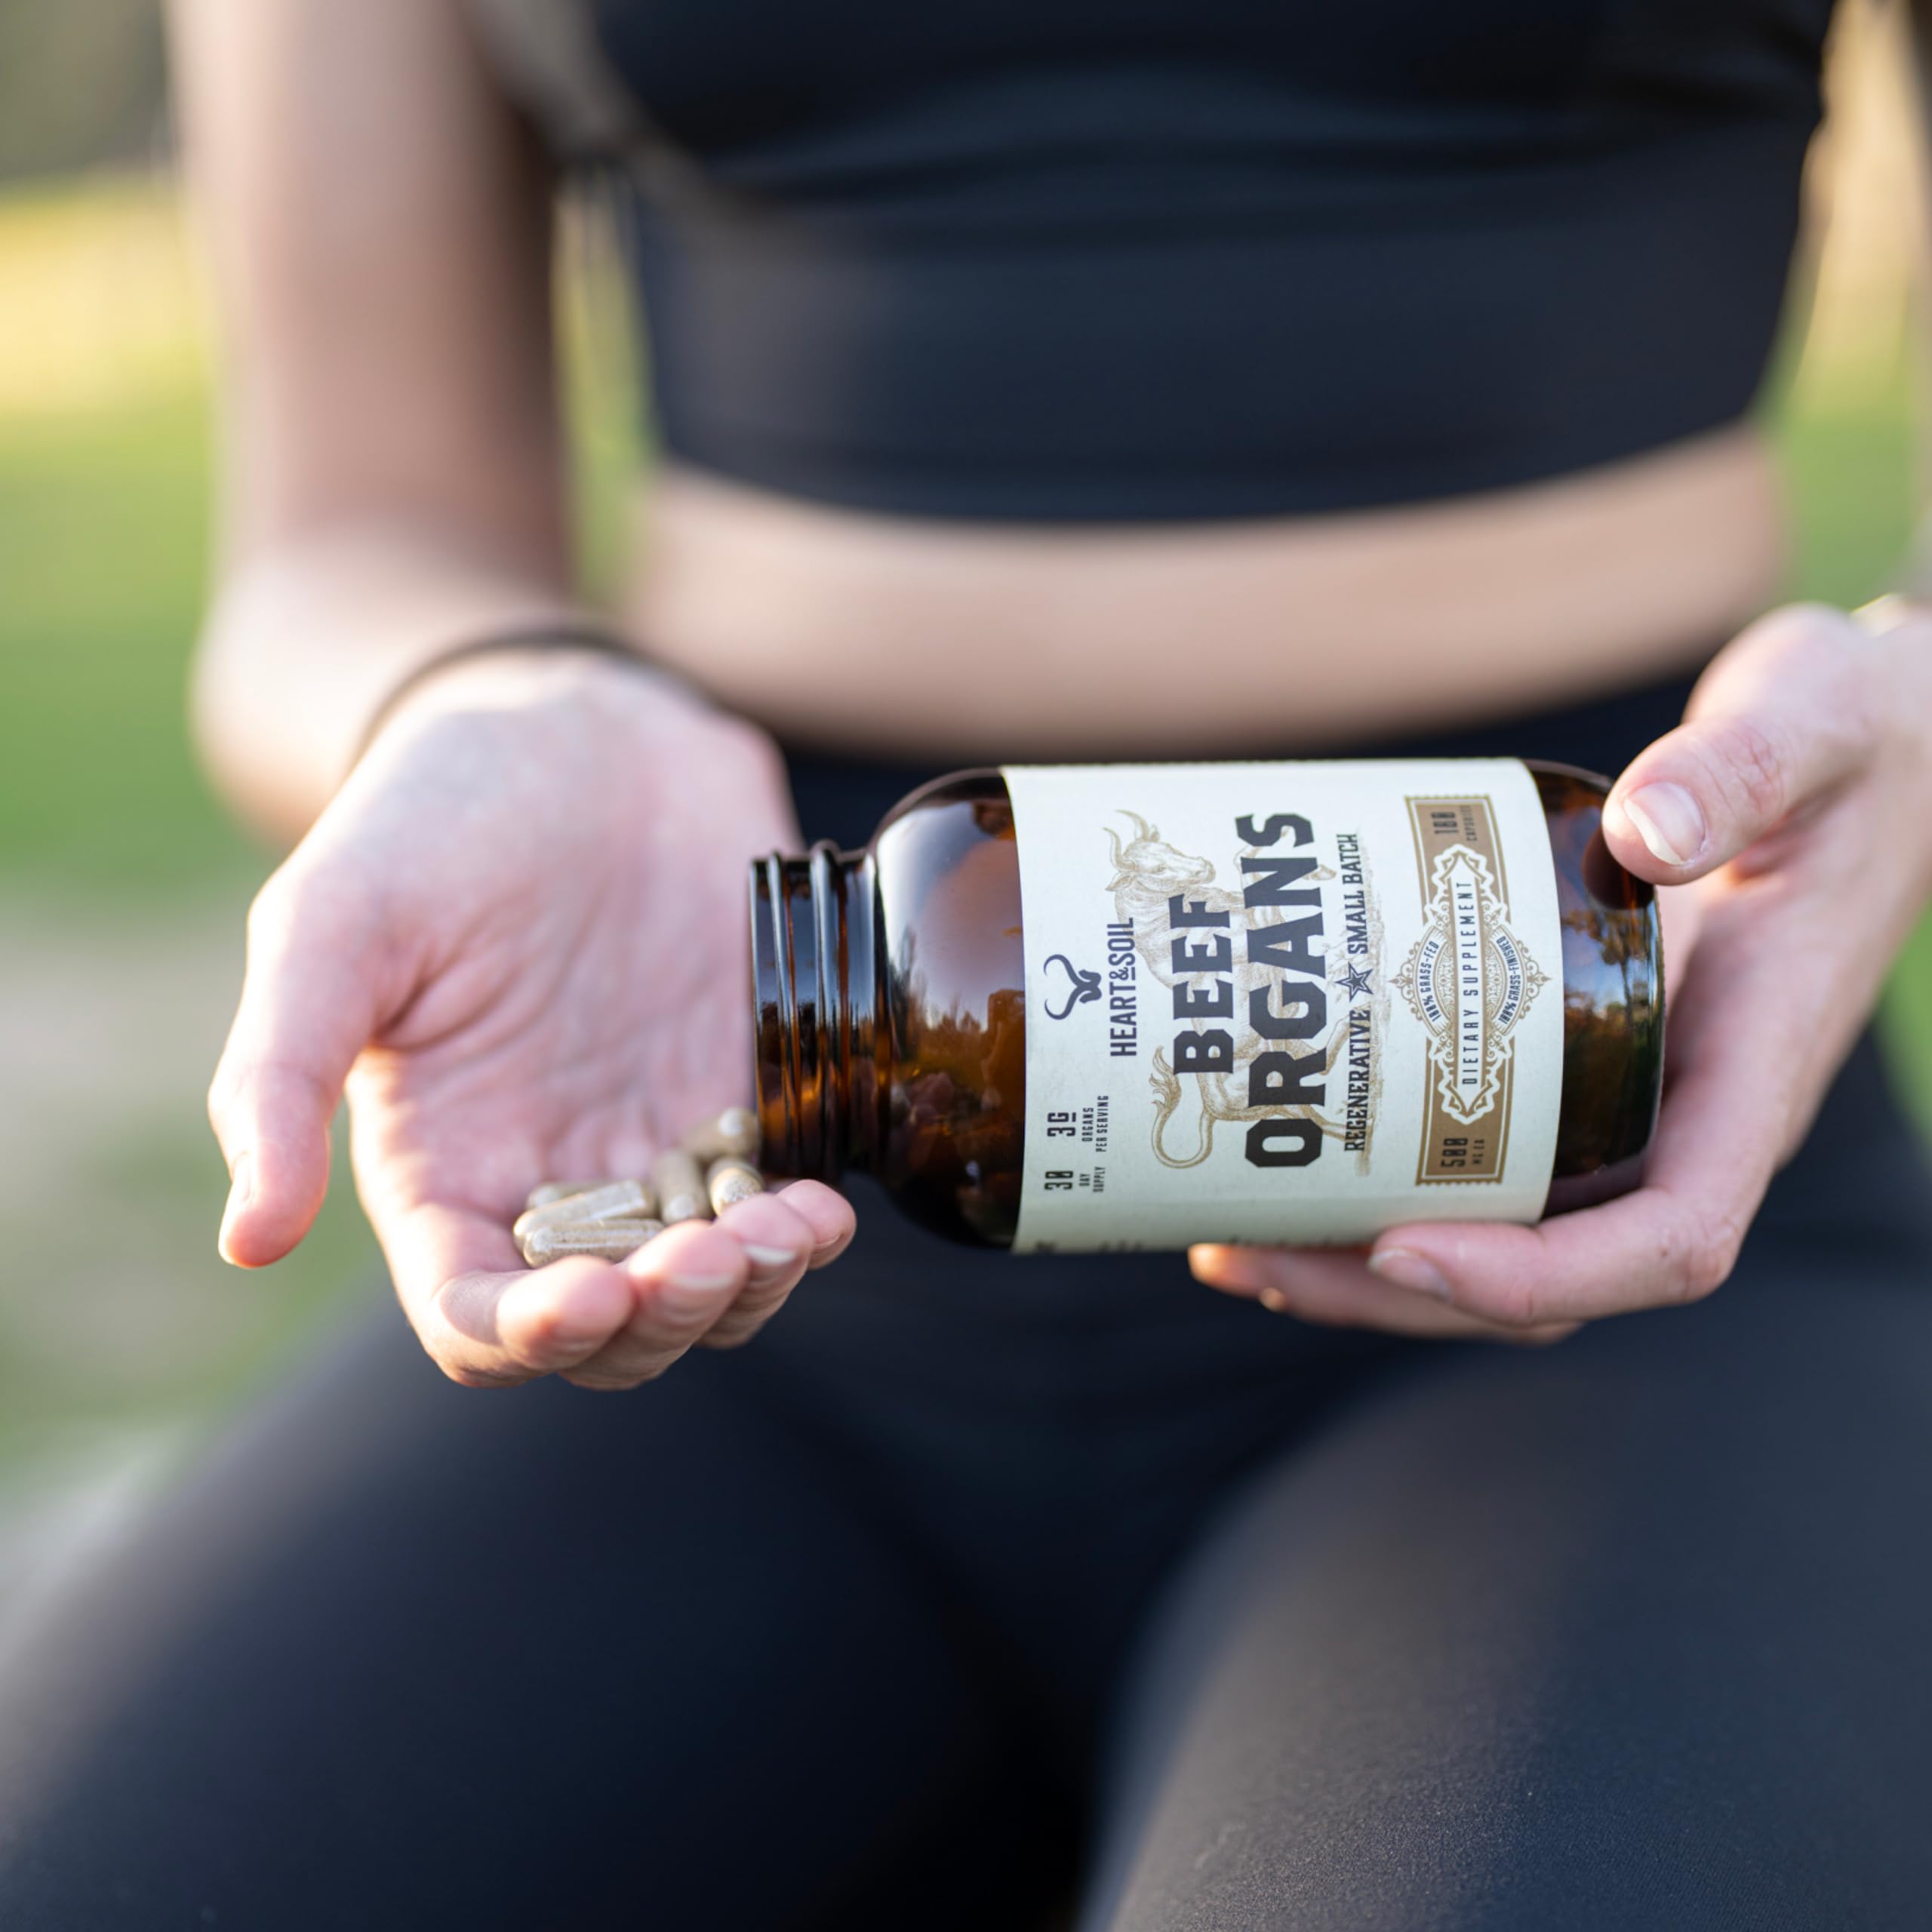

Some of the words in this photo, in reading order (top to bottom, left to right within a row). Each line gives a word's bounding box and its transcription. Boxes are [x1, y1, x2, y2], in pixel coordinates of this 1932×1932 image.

[1336, 833, 1364, 884] BATCH
[1343, 890, 1369, 955] SMALL
[1456, 882, 1479, 997] SUPPLEMENT
[1106, 917, 1137, 1057] HEART&SOIL
[1168, 894, 1234, 1075] BEEF
[1235, 813, 1327, 1168] ORGANS
[1419, 940, 1439, 993] GRASS-FED
[1496, 935, 1521, 1001] GRASS-FINISHED
[1423, 995, 1441, 1022] 100%
[1462, 1009, 1479, 1084] DIETARY
[1344, 1009, 1371, 1152] REGENERATIVE
[1047, 1112, 1076, 1137] 3G
[1081, 1107, 1094, 1142] ORGANS
[1097, 1095, 1109, 1134] SERVING
[1095, 1137, 1108, 1152] PER
[1440, 1137, 1469, 1168] 500
[1044, 1171, 1074, 1191] 30
[1078, 1173, 1091, 1187] DAY
[1092, 1166, 1106, 1193] SUPPLY
